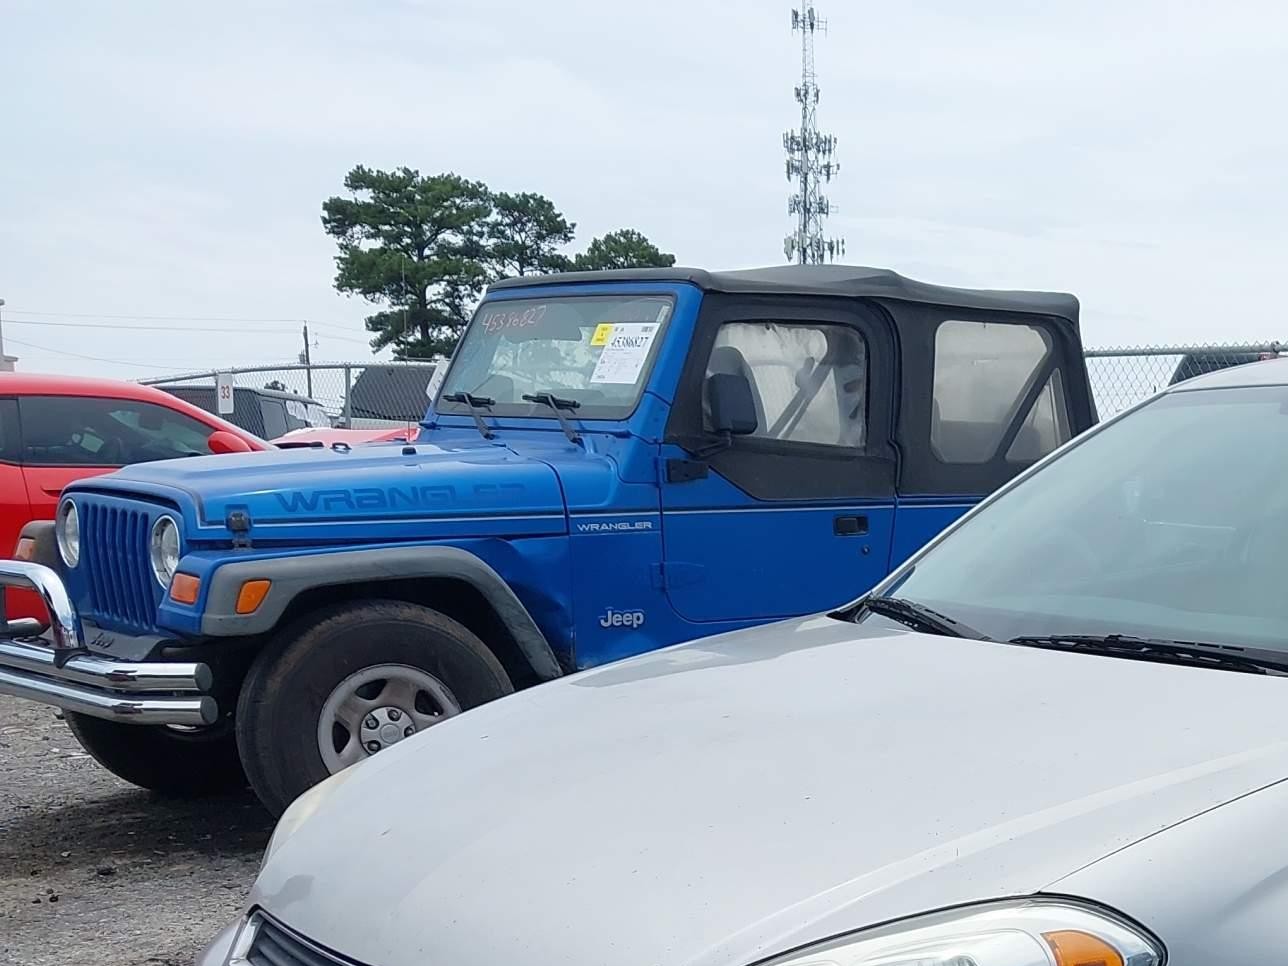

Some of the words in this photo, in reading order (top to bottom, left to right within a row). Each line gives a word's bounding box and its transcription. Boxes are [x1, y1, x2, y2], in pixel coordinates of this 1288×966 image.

[221, 385, 231, 399] 33
[274, 482, 527, 512] WRANGER
[577, 521, 652, 532] WRANGLER
[600, 610, 644, 628] Jeep
